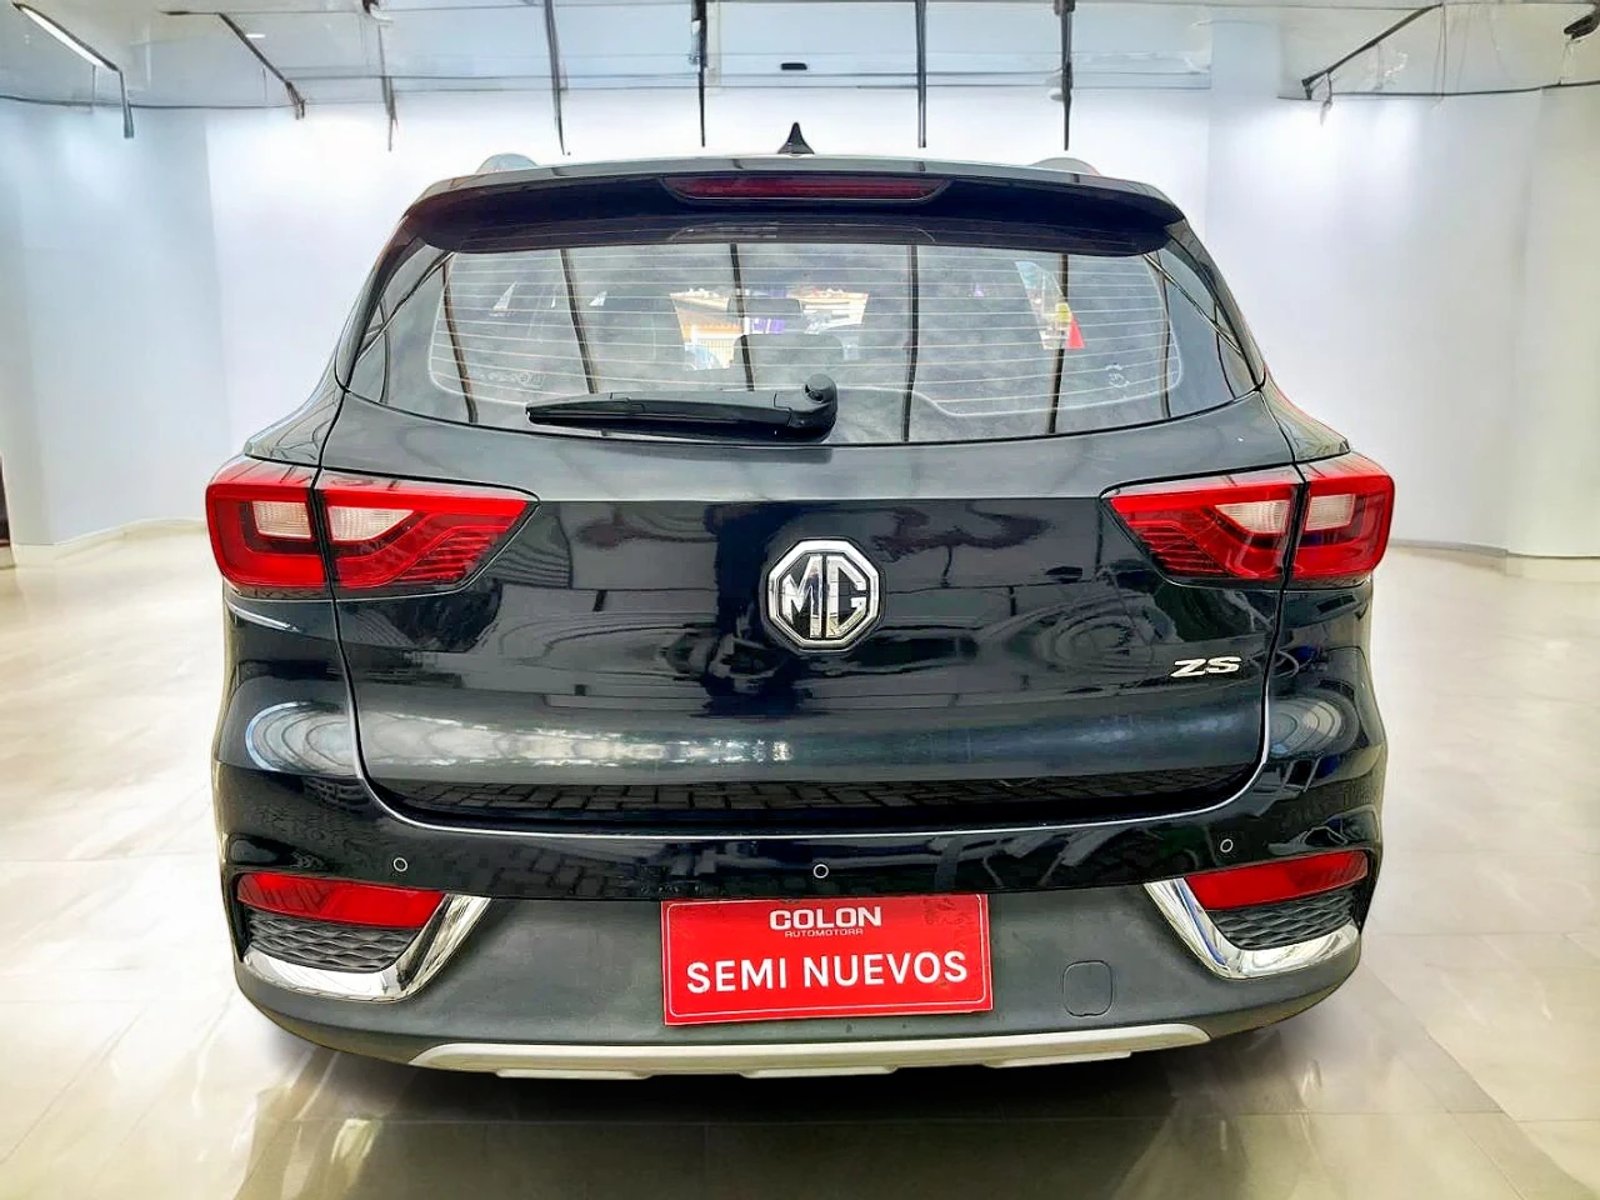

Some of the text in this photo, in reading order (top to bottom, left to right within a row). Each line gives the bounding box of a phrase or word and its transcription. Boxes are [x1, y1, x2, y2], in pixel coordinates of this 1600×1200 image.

[780, 553, 868, 639] MG
[1170, 656, 1242, 678] ZS
[769, 906, 882, 930] COLON
[784, 928, 864, 938] AUTOMOTORA
[686, 950, 968, 994] SEMI NUEVOS
